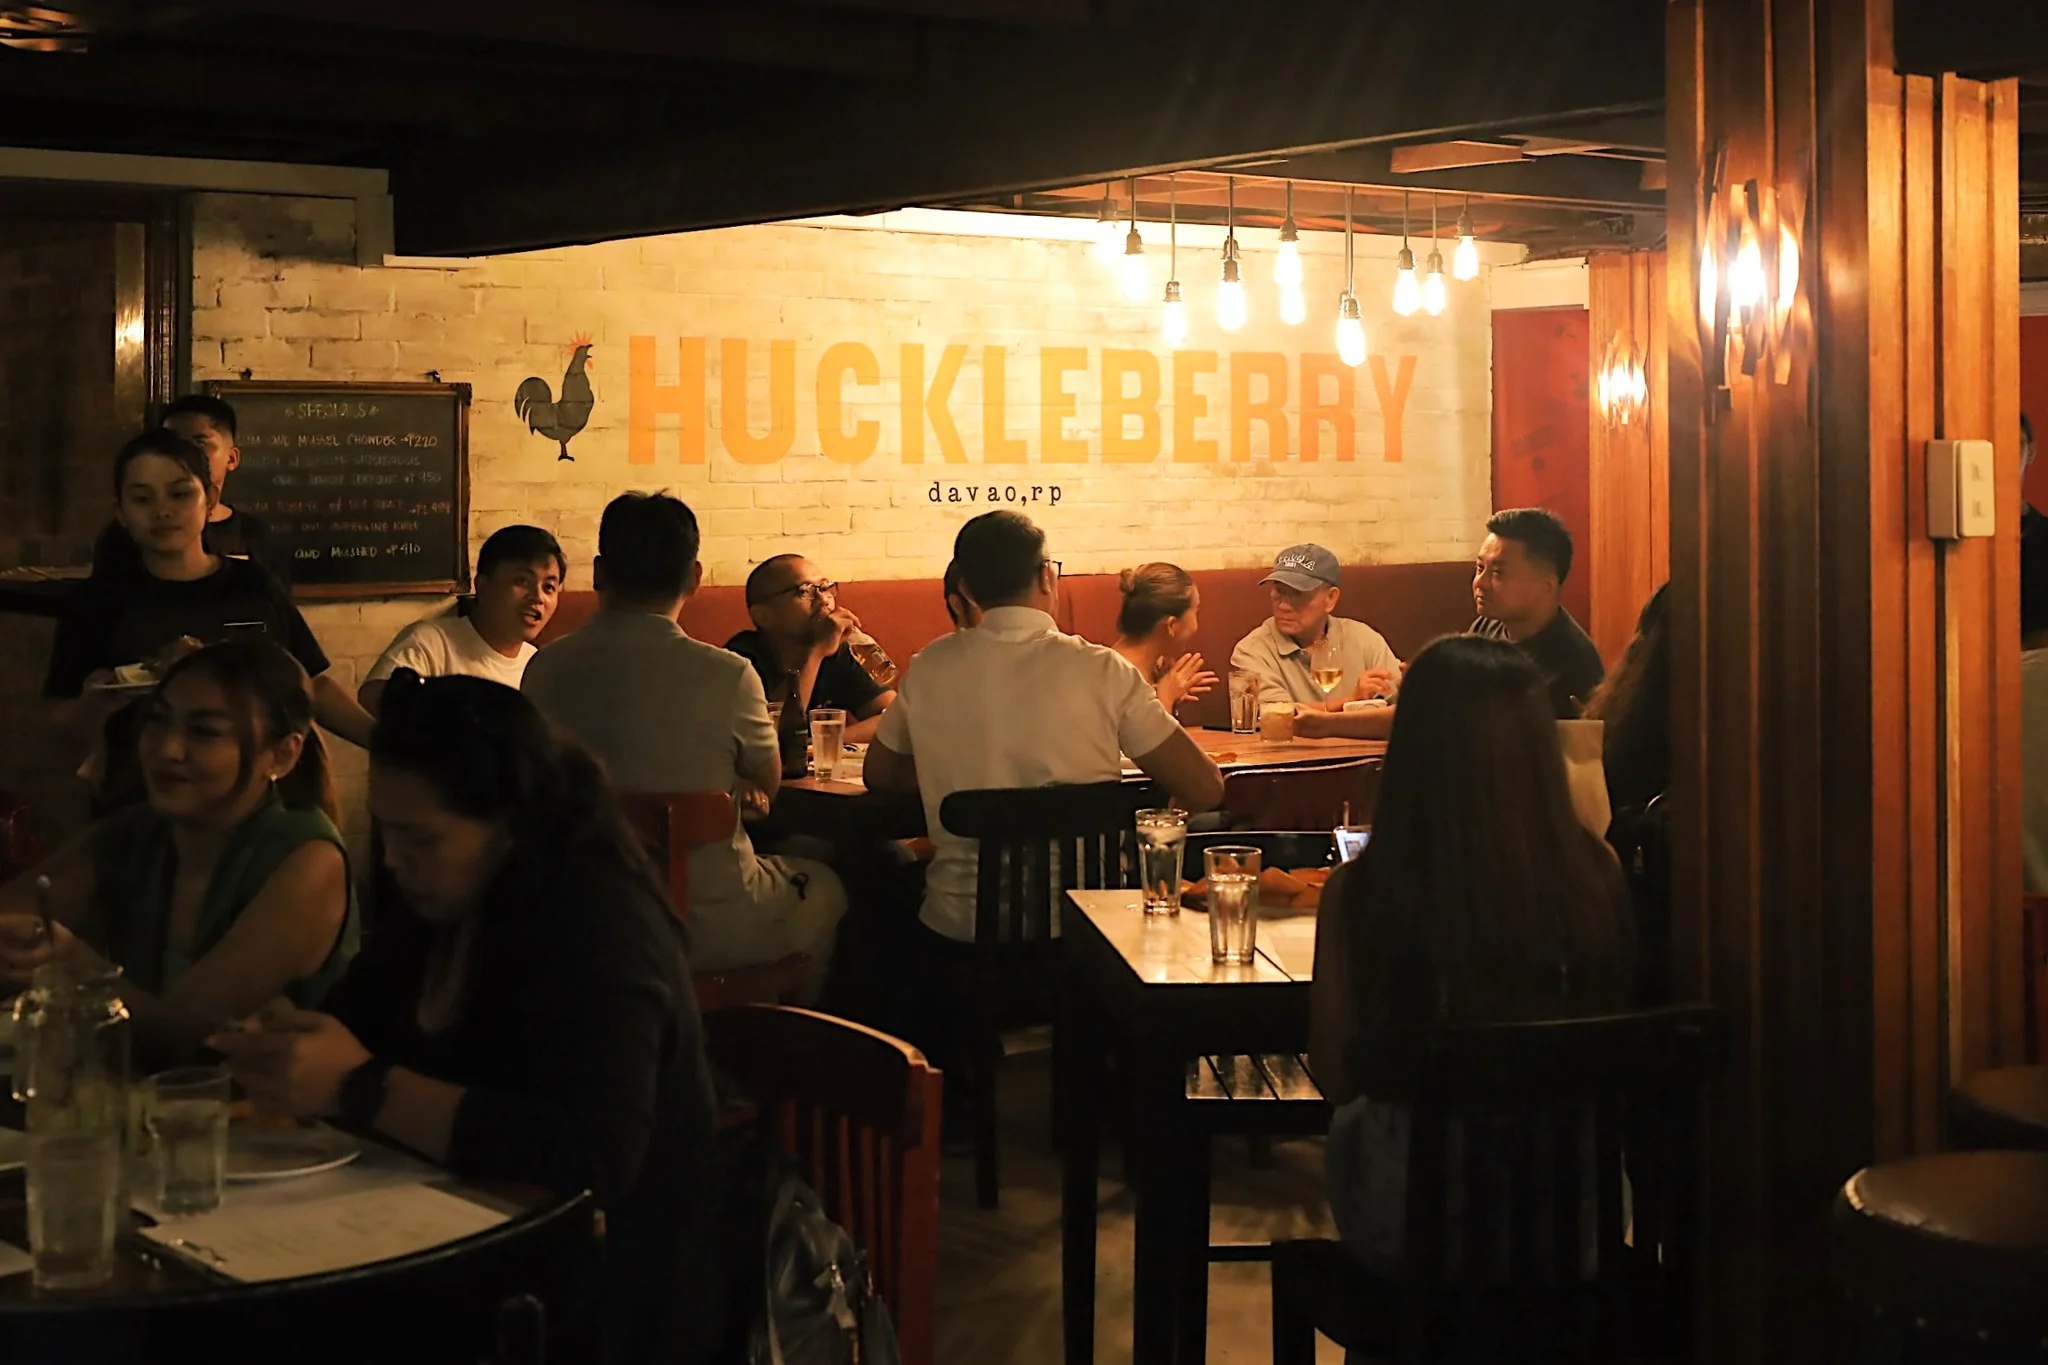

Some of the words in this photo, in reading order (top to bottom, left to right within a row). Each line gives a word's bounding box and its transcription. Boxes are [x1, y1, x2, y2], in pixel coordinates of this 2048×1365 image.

[298, 402, 366, 419] SPECIAS
[628, 335, 1418, 464] HUCKLEBERRY
[928, 482, 1062, 506] davao,rp
